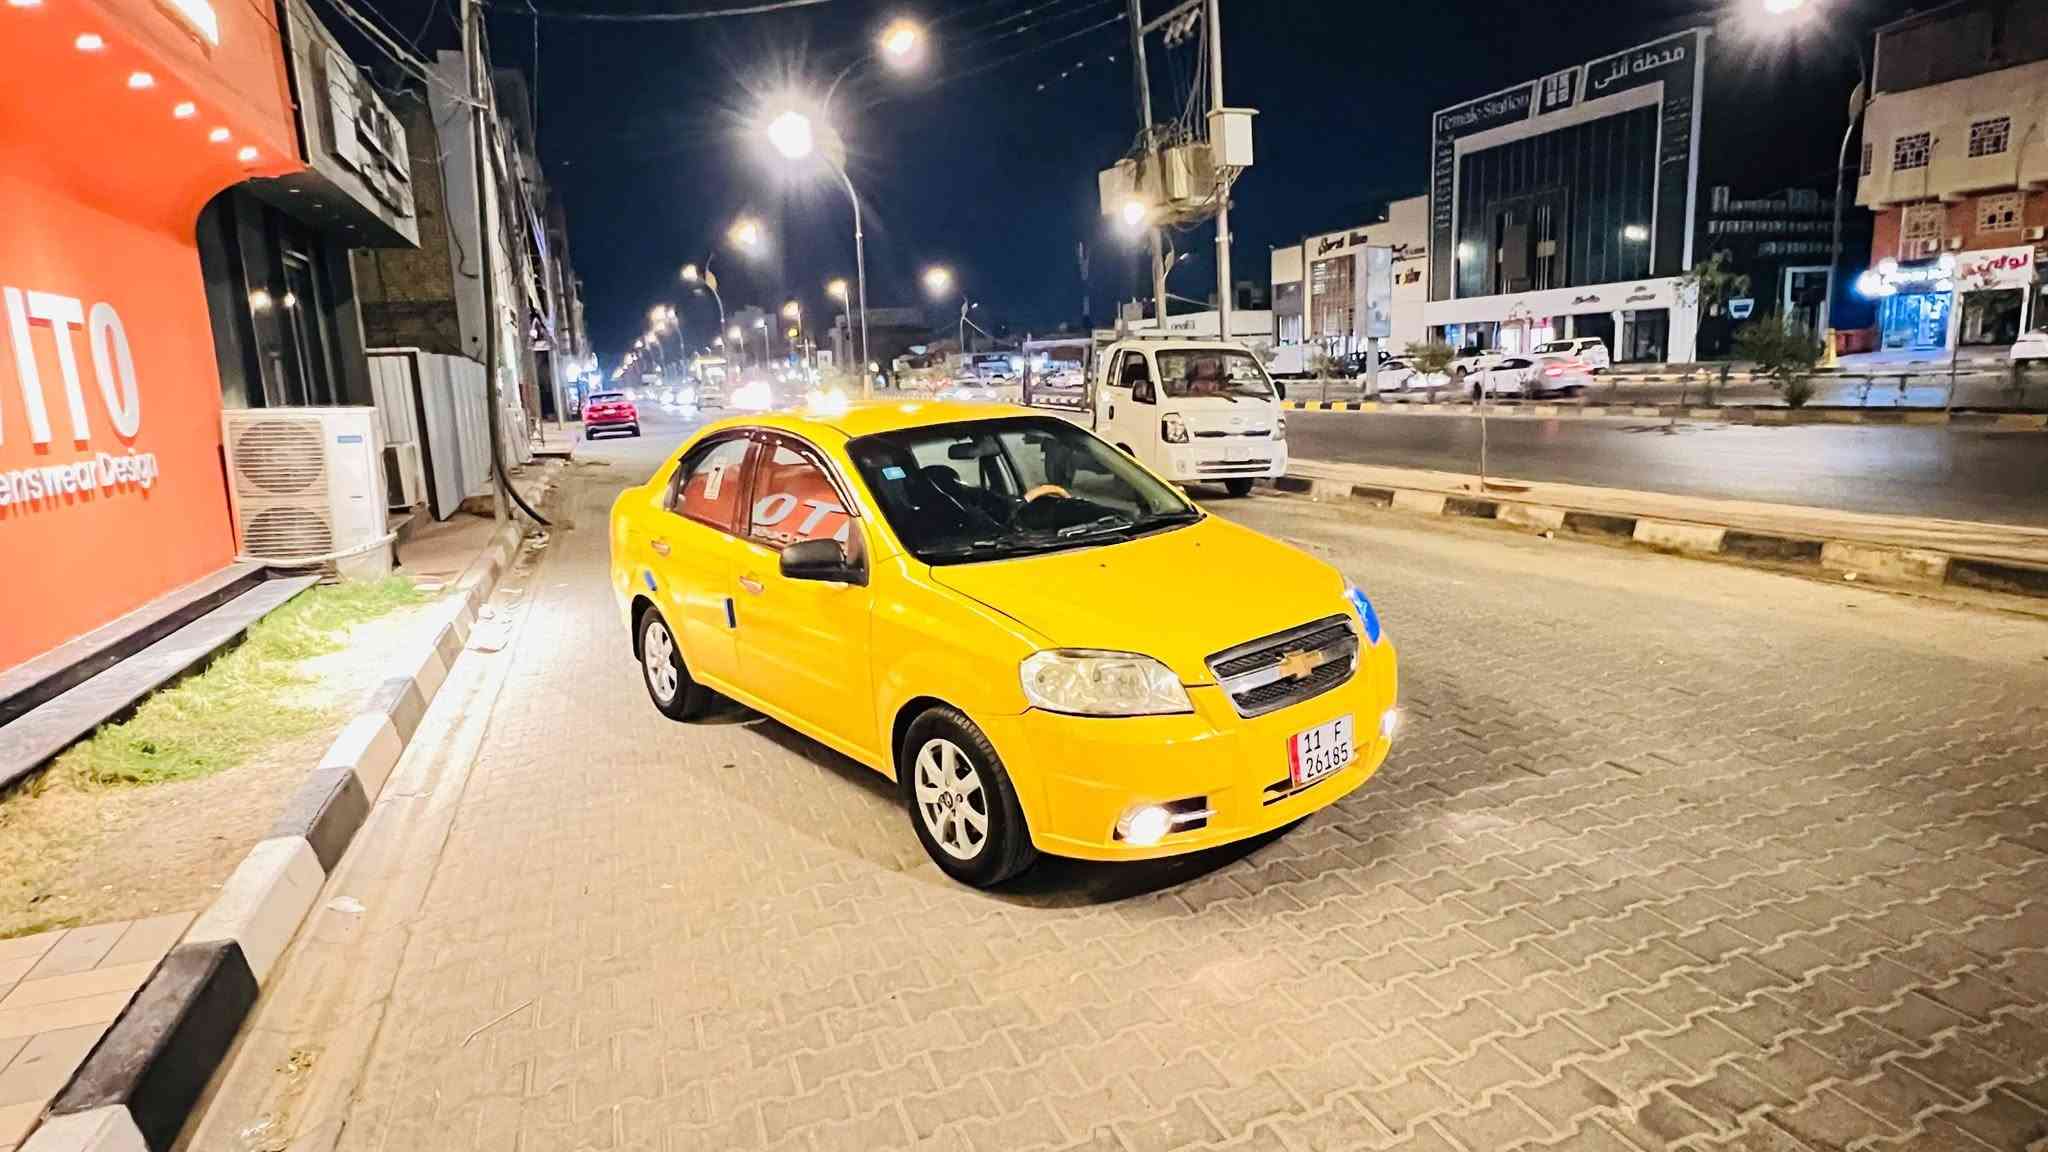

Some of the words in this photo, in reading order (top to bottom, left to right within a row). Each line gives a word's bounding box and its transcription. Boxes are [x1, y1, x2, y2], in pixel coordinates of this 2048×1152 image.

[1632, 46, 1686, 73] محطة
[0, 286, 140, 443] ITO
[1304, 730, 1321, 754] 11
[1334, 720, 1342, 742] F
[1306, 742, 1349, 778] 26185
